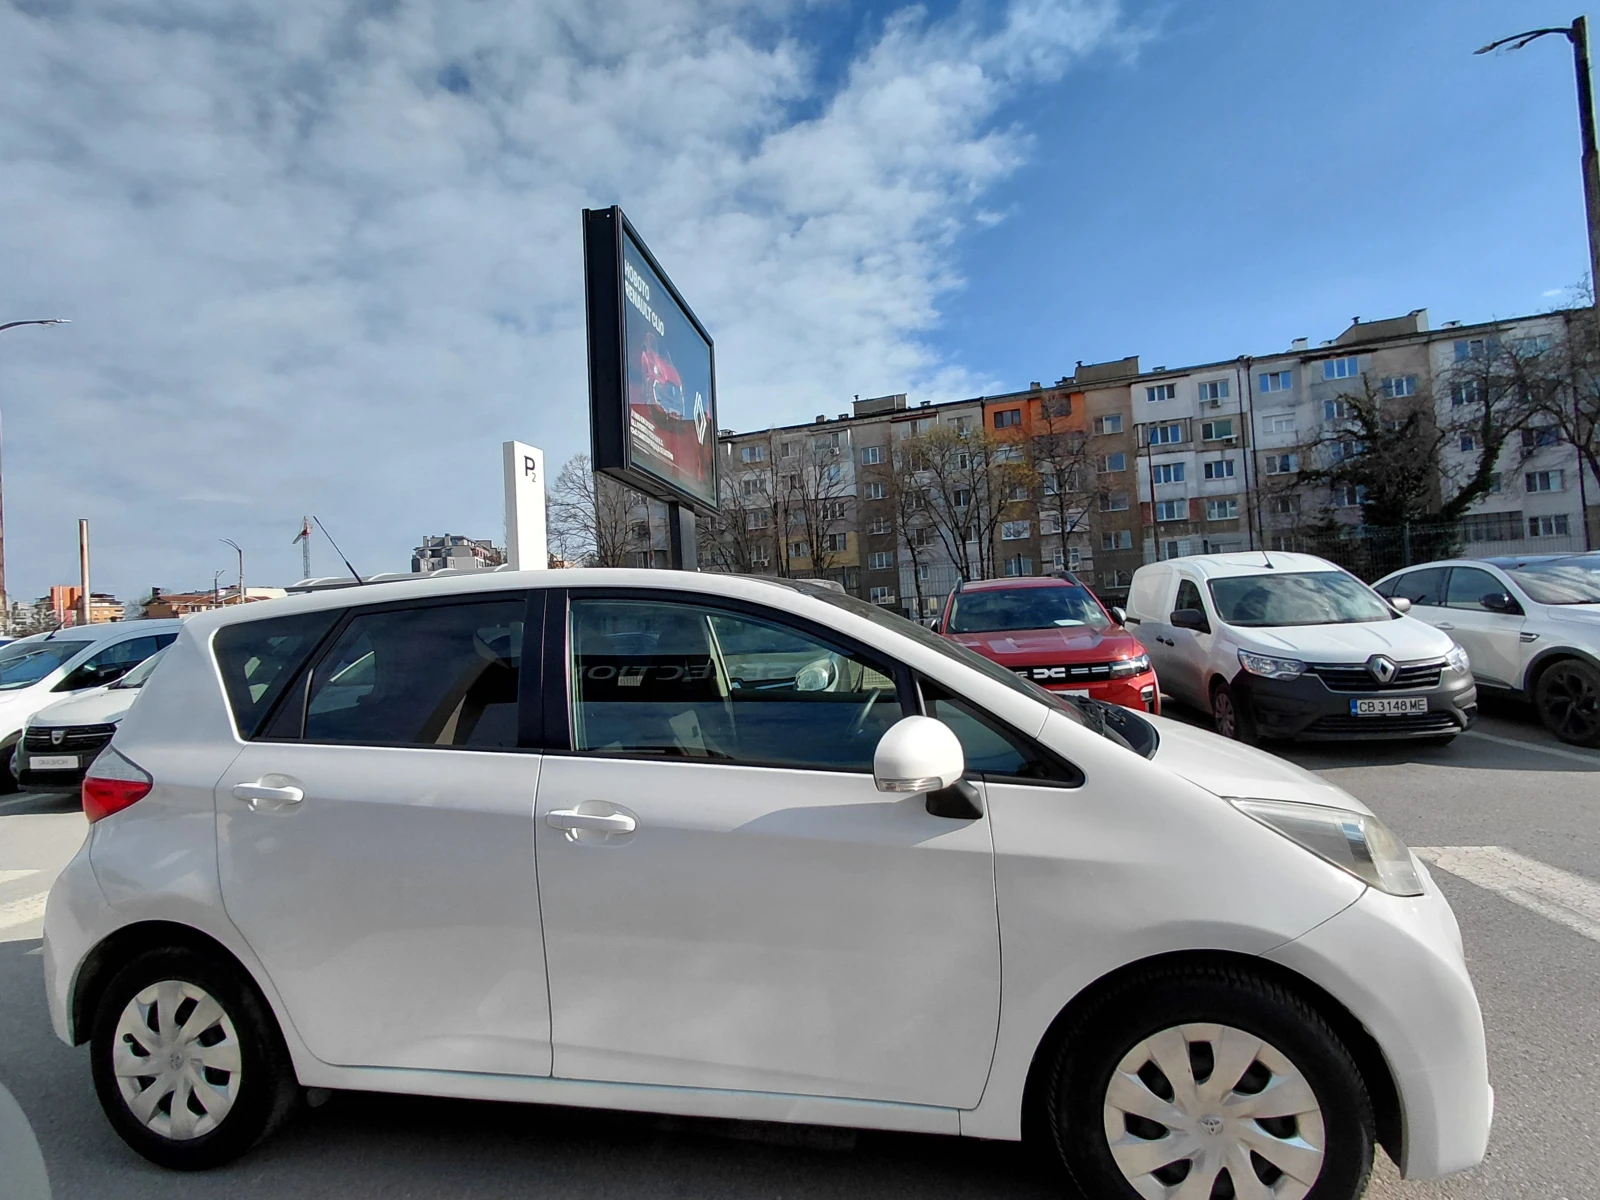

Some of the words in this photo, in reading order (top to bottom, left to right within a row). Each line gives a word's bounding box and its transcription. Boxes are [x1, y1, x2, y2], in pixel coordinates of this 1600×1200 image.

[625, 259, 650, 302] НОВОТО
[652, 311, 665, 337] CLIO
[1359, 701, 1376, 713] CB
[1378, 700, 1408, 712] 3148
[1409, 699, 1426, 711] ME
